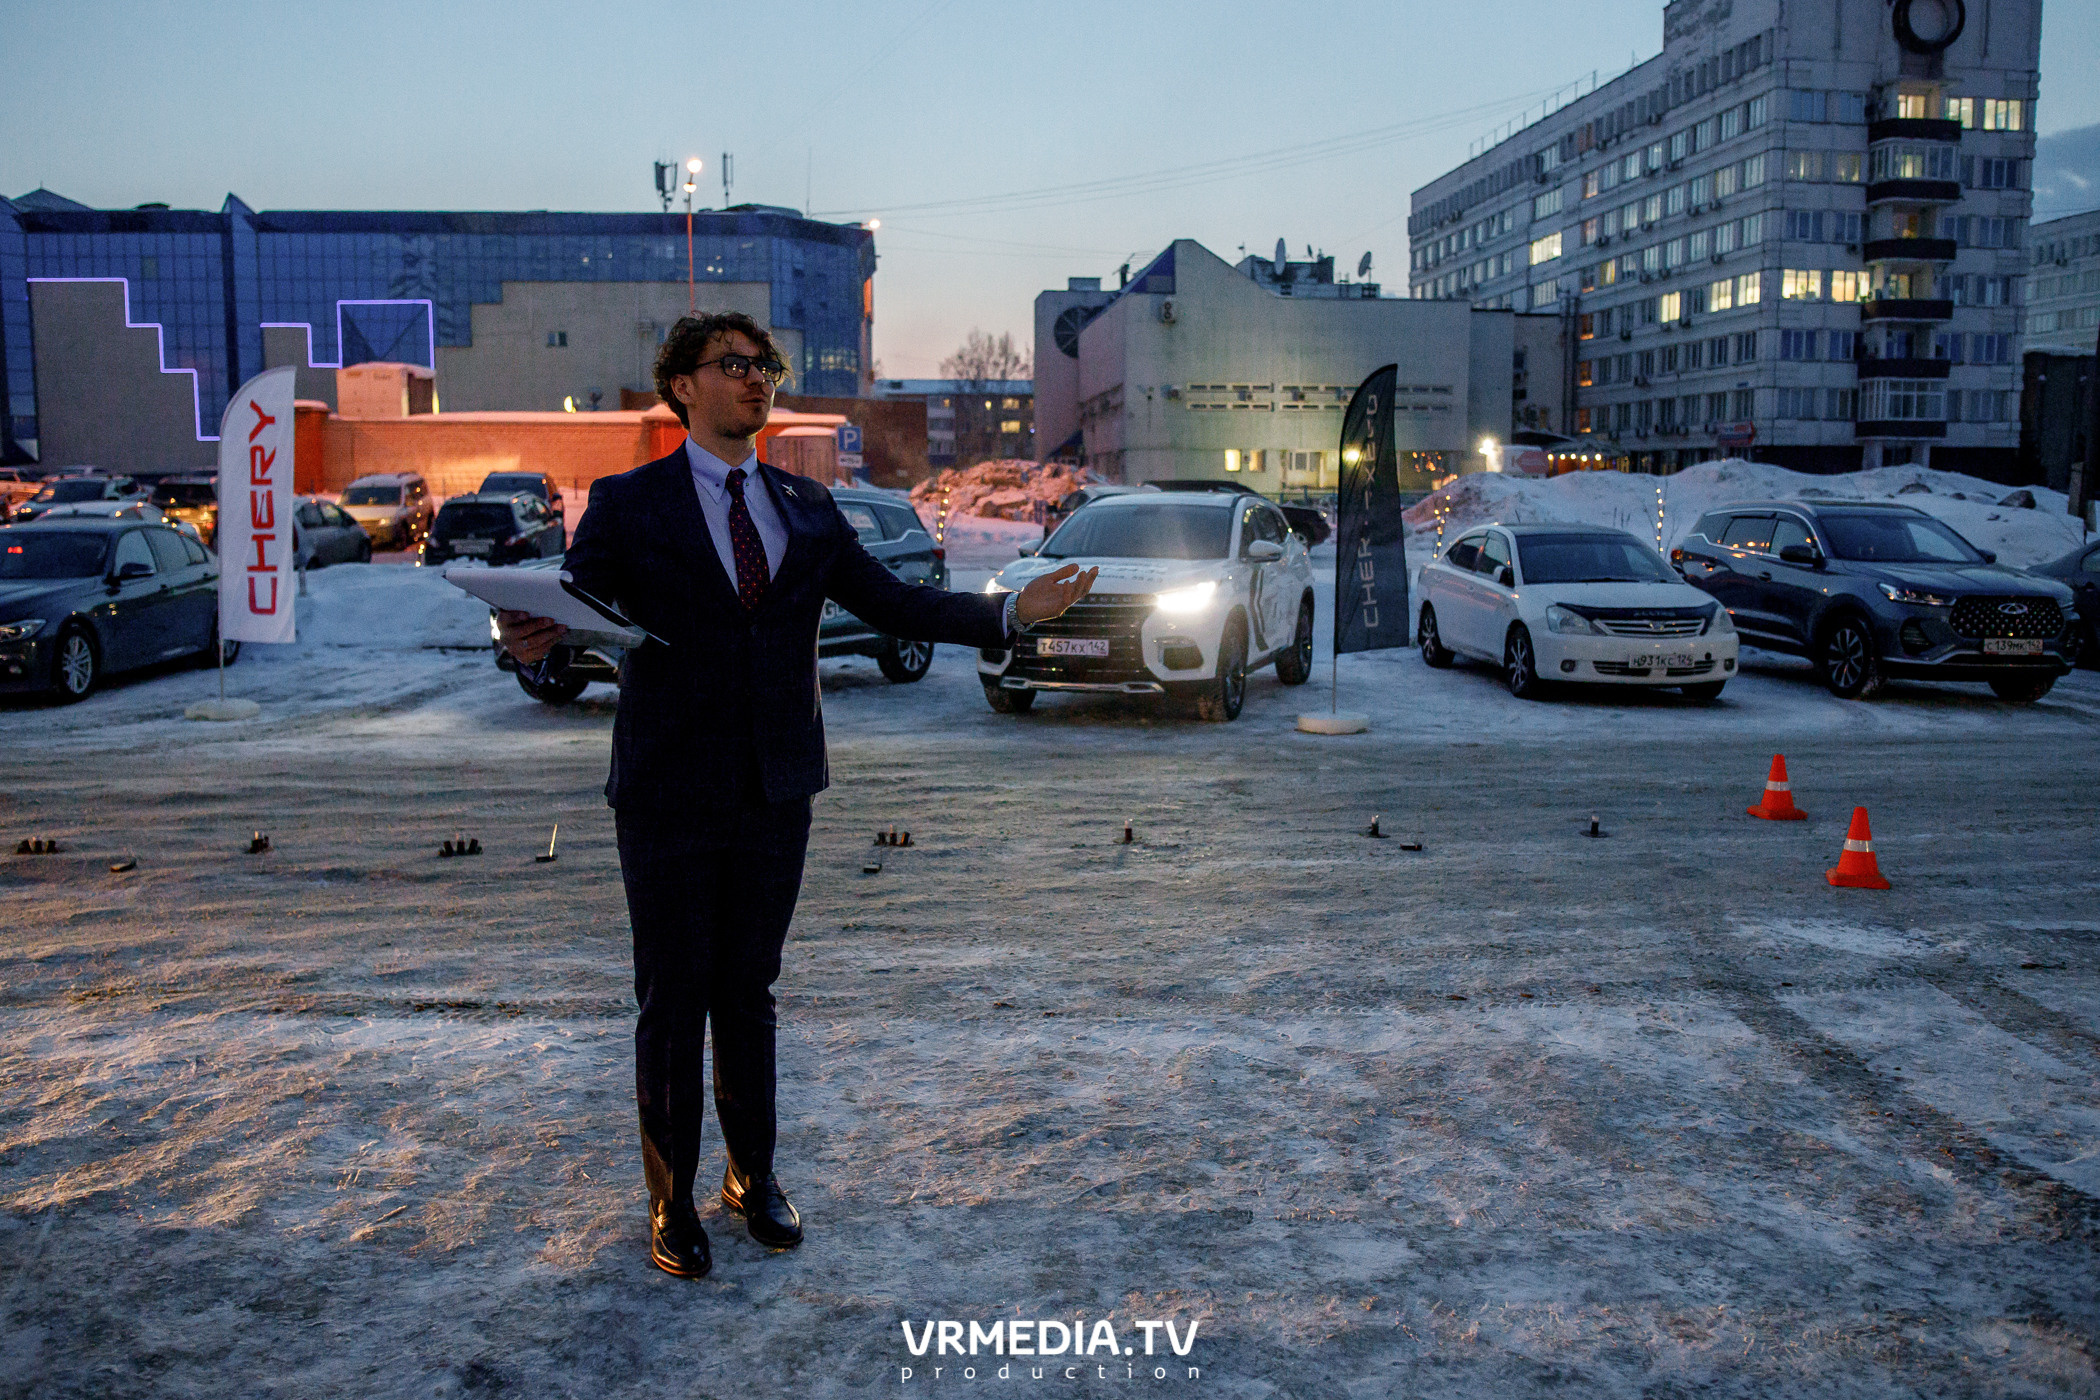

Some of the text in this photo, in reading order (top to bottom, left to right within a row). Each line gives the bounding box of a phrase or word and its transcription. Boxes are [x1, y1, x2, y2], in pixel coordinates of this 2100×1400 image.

[844, 429, 858, 450] P
[248, 400, 277, 615] CHERY
[1088, 641, 1106, 652] 142
